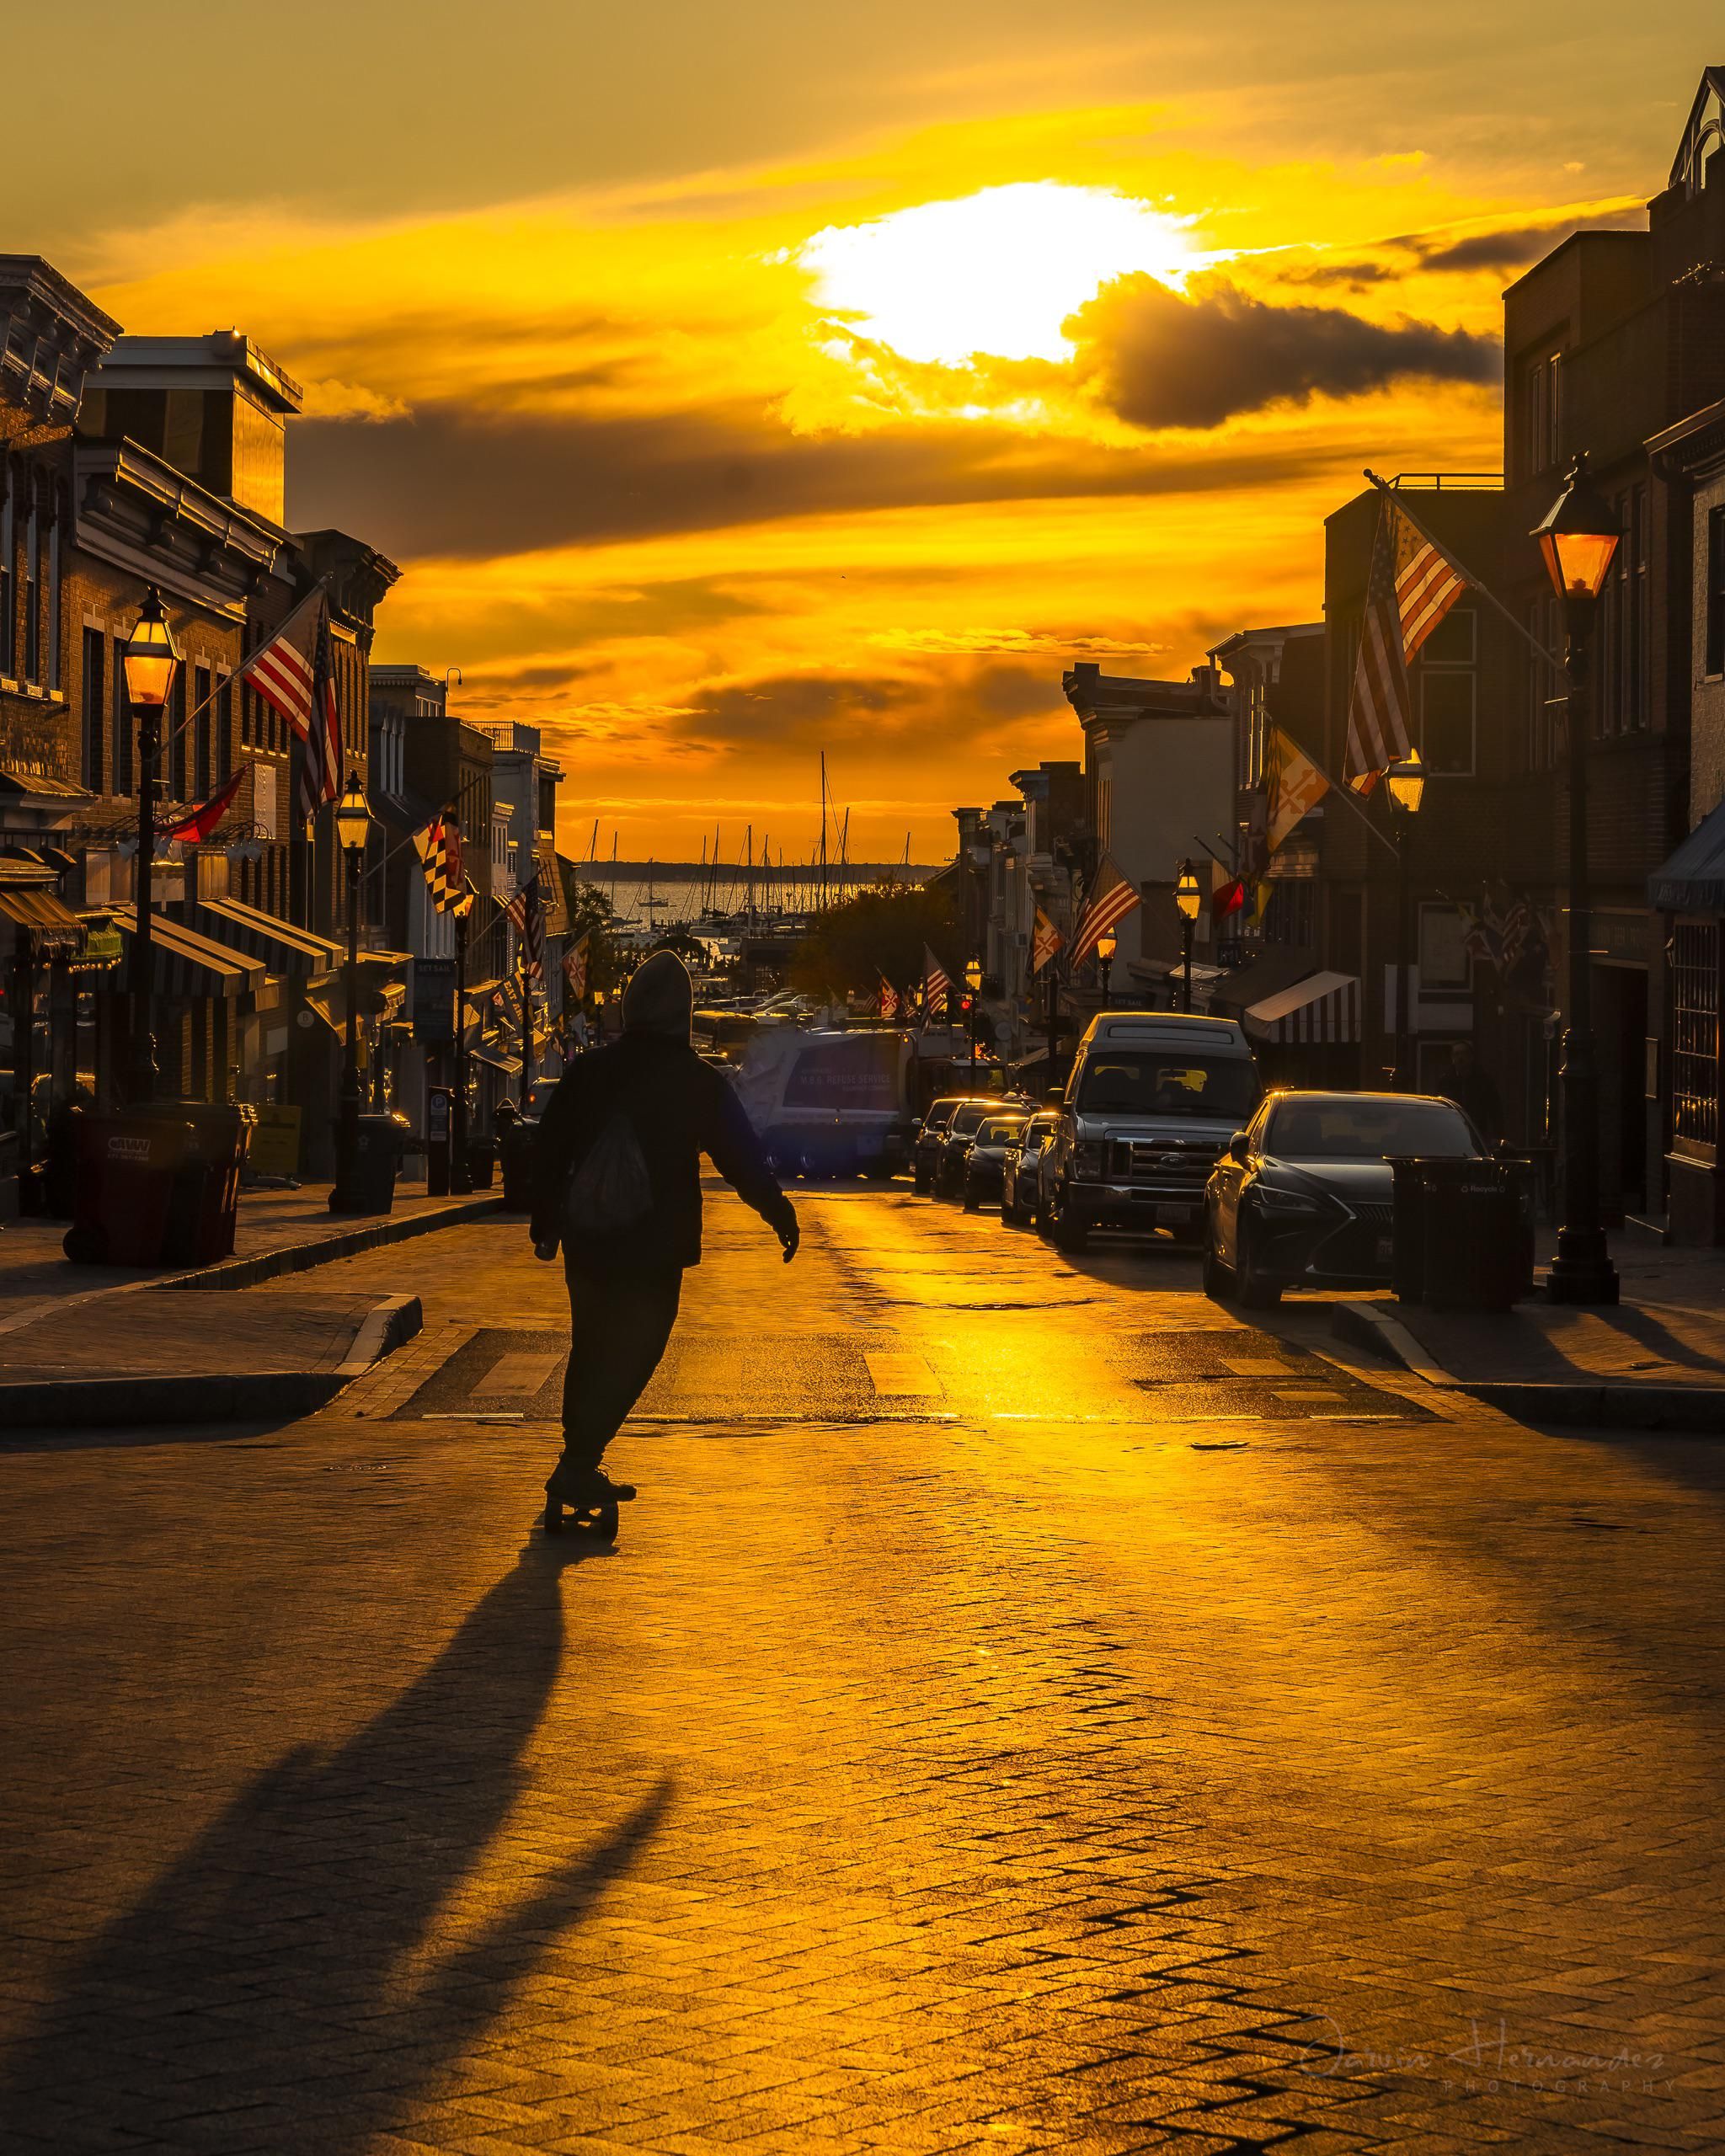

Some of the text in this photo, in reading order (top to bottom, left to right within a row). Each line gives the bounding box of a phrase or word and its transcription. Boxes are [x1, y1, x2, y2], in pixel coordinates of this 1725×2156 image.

[433, 964, 451, 973] SAIL
[826, 1075, 857, 1085] REFUSE
[858, 1074, 890, 1084] SERVICE
[435, 1097, 443, 1107] P
